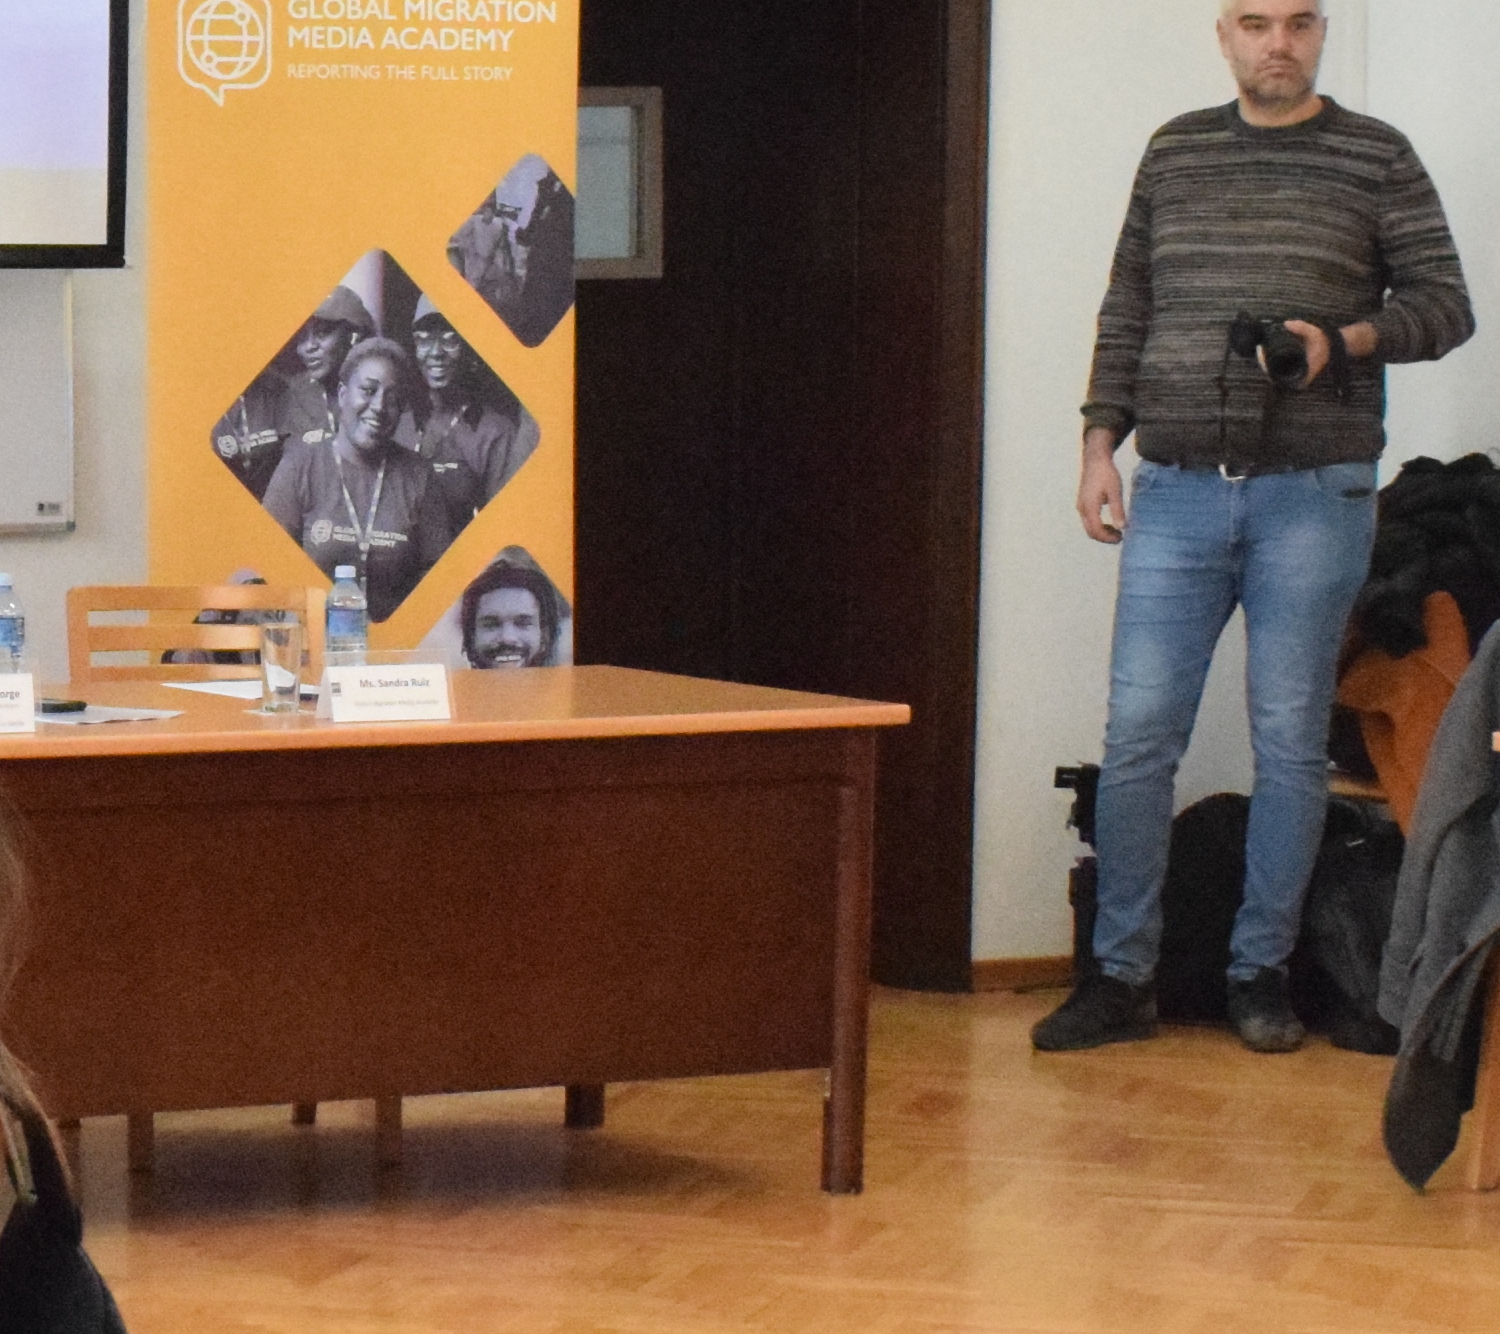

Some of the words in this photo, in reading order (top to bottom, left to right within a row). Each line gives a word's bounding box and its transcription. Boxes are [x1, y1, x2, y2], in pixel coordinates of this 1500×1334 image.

[287, 25, 374, 51] MEDIA
[380, 27, 514, 52] ACADEMY
[287, 62, 380, 81] REPORTING
[385, 64, 416, 81] THE
[420, 65, 459, 81] FULL
[463, 65, 514, 82] STORY
[378, 678, 409, 688] Sandra
